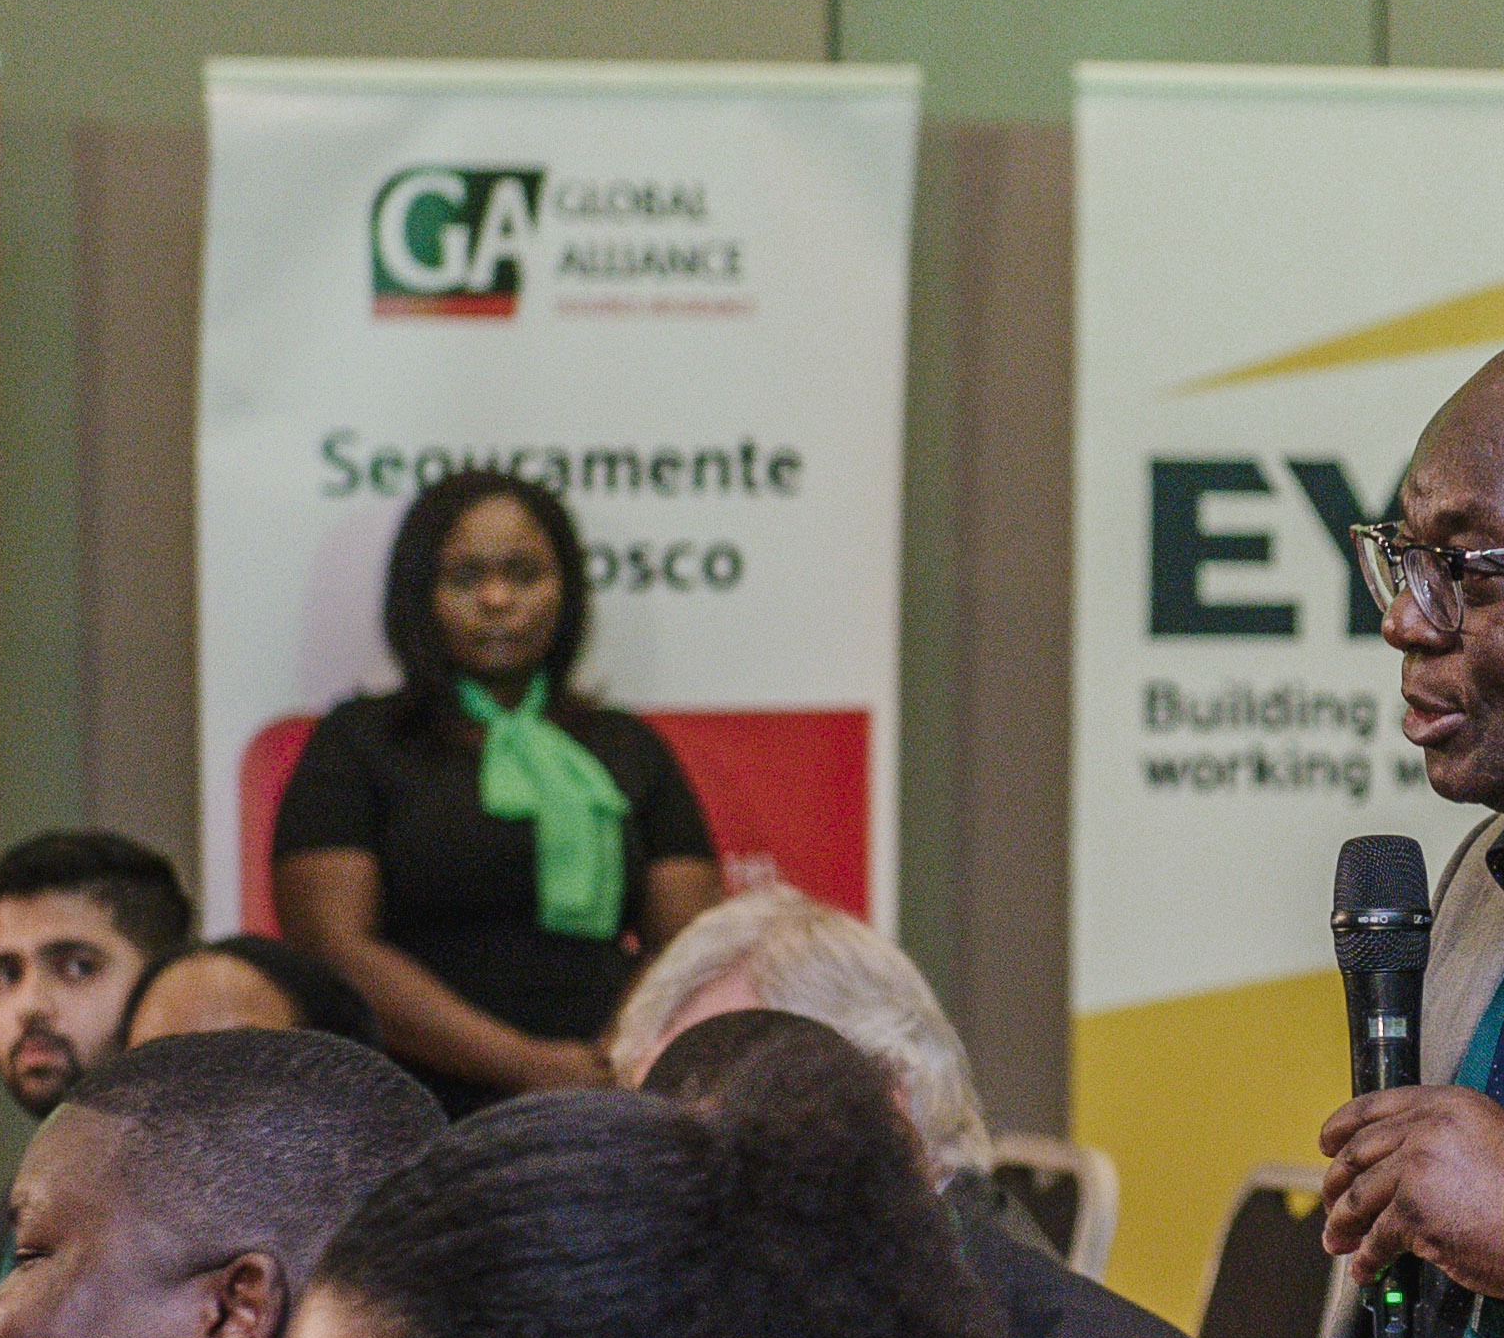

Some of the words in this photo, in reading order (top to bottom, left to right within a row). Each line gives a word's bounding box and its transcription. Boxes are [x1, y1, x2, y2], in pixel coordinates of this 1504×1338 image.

[552, 179, 708, 223] GLOBAL
[376, 168, 542, 292] GA
[555, 239, 745, 283] ALLIANCE
[584, 542, 745, 591] osco
[1149, 460, 1407, 636] EY
[1144, 682, 1379, 739] Building
[1143, 747, 1373, 805] working
